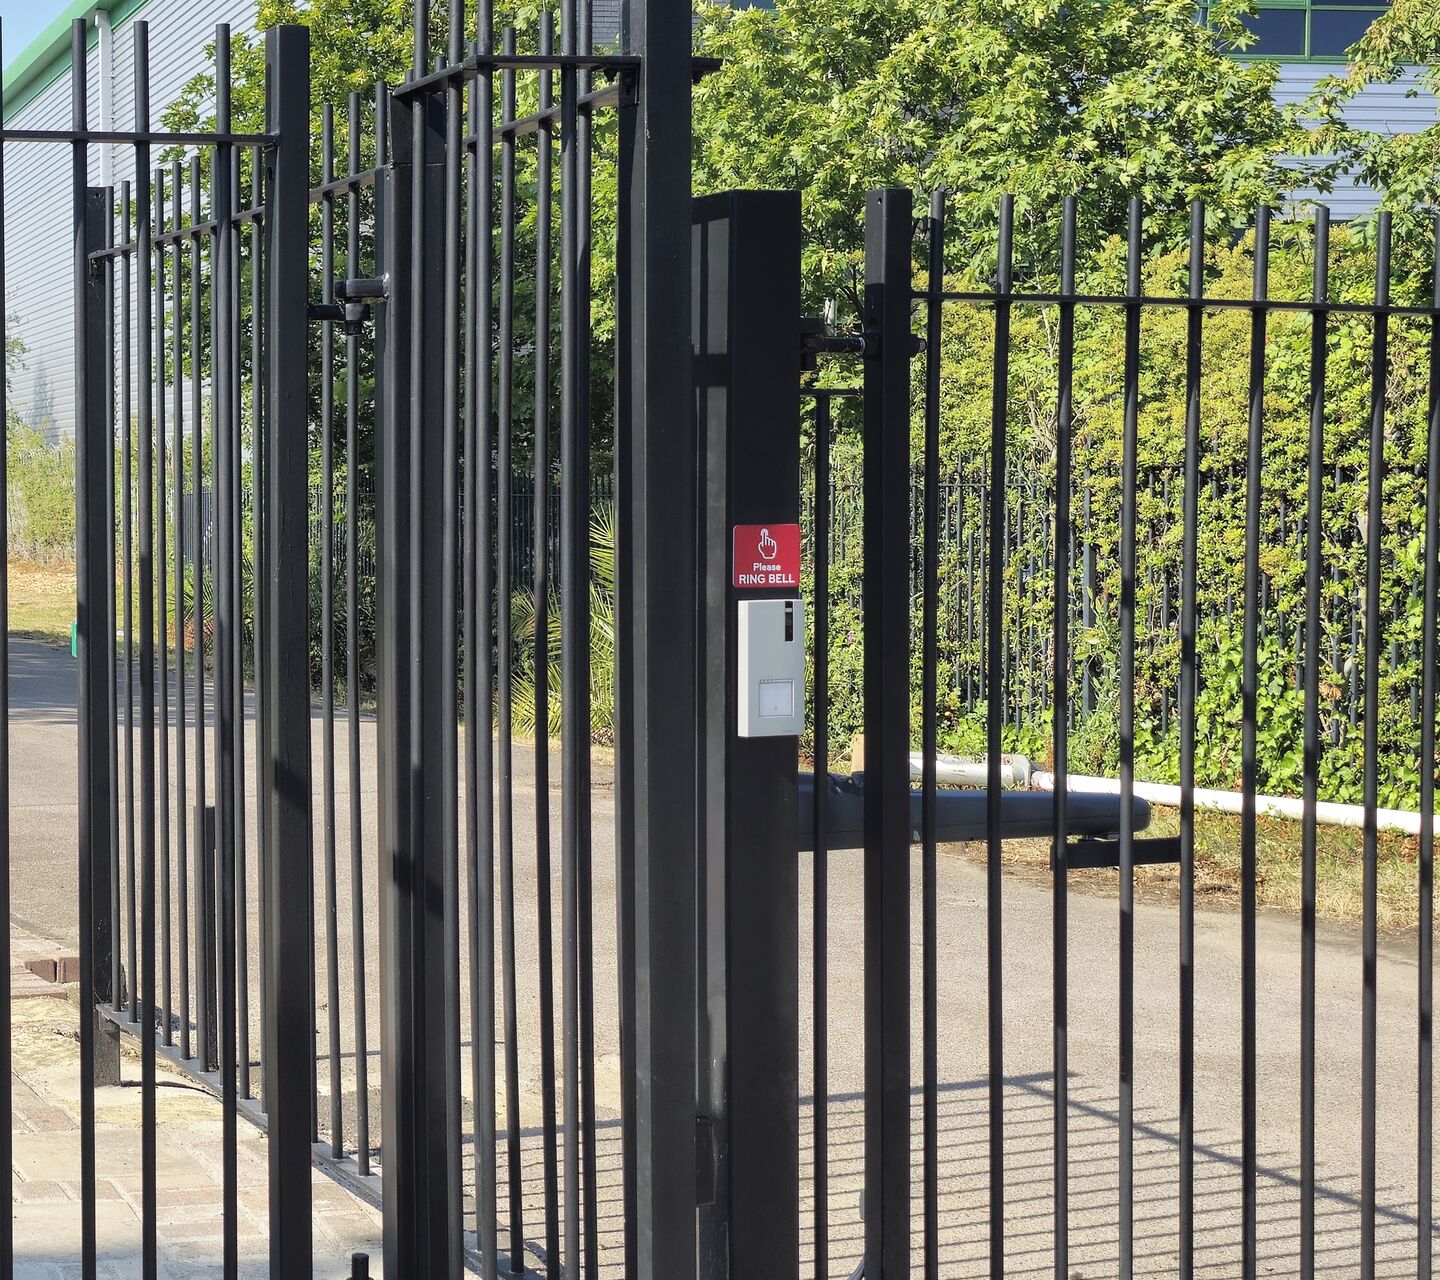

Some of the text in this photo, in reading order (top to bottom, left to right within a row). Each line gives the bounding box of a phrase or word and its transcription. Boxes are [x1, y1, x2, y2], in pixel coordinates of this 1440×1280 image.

[753, 562, 781, 571] Please
[738, 573, 796, 585] RING BELL
